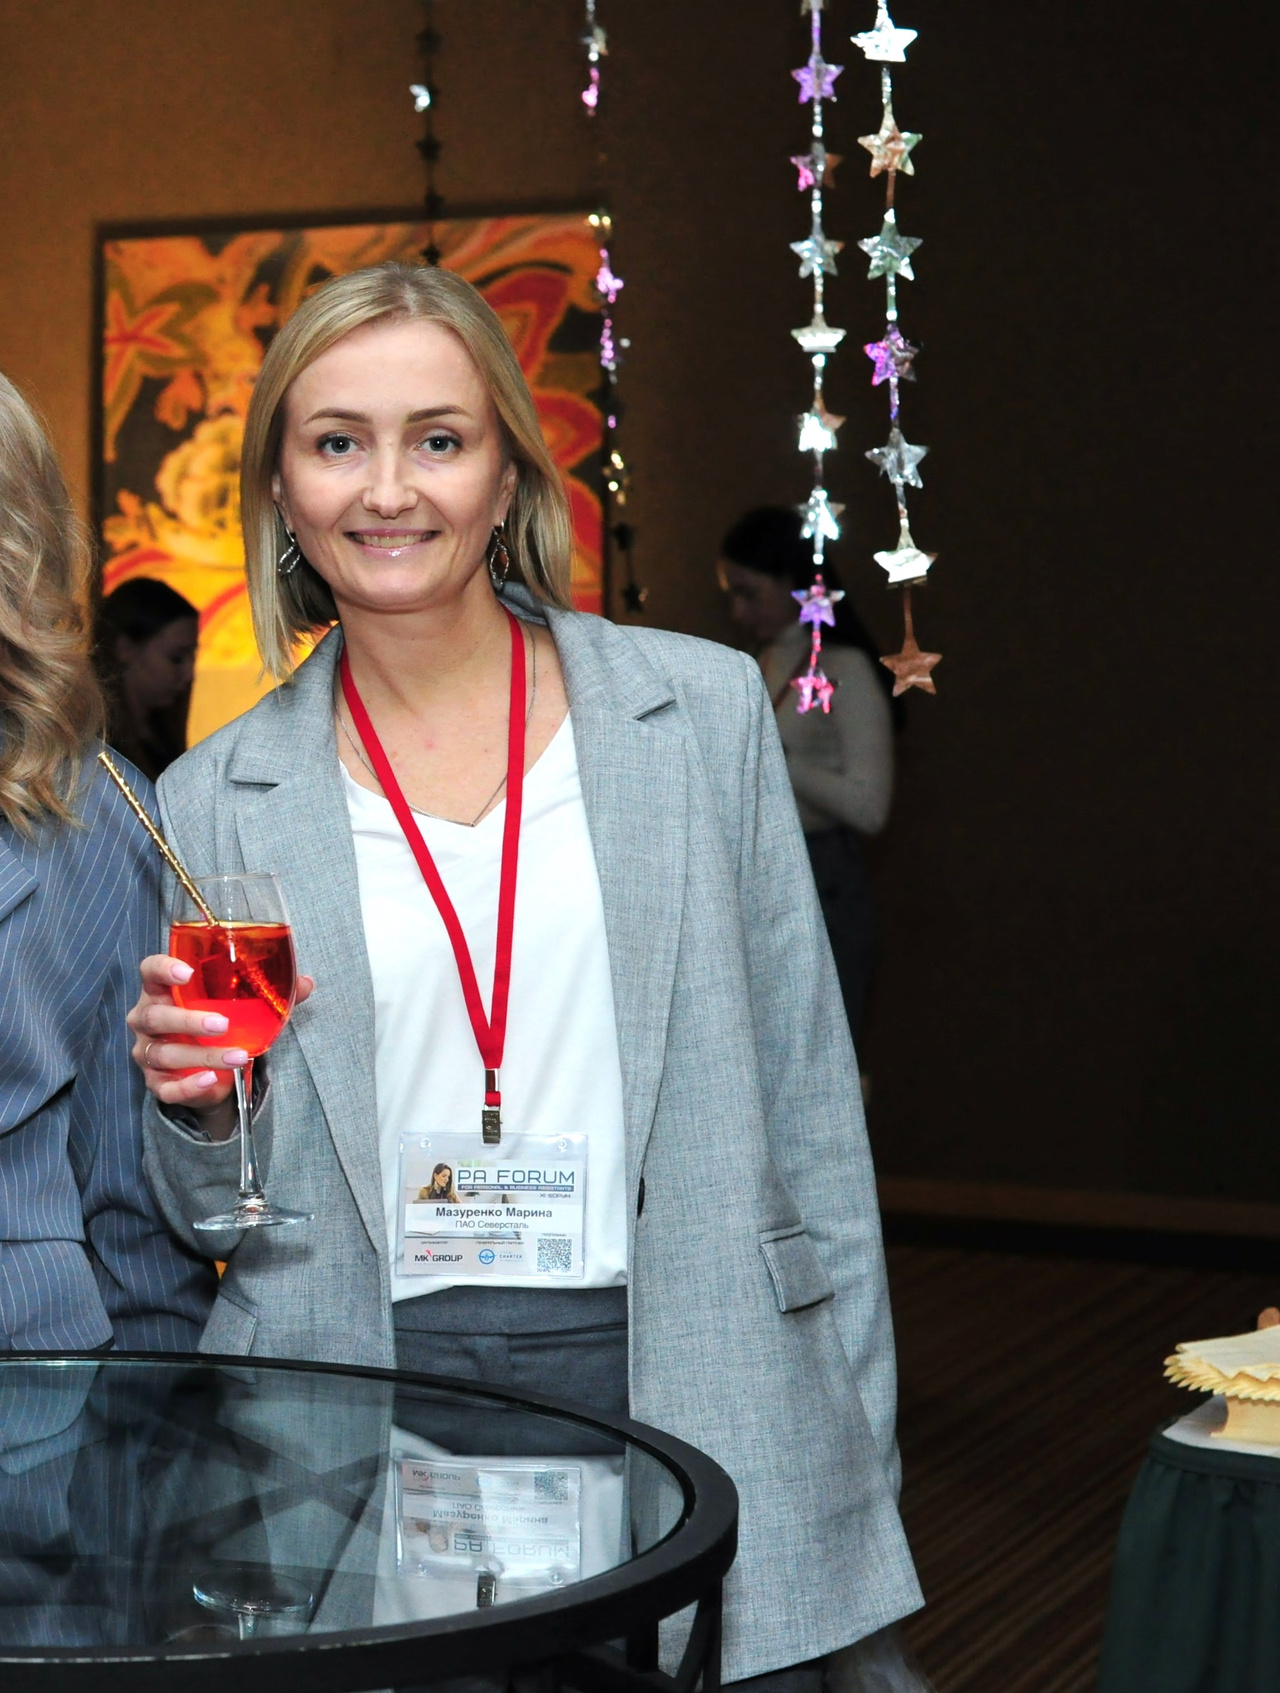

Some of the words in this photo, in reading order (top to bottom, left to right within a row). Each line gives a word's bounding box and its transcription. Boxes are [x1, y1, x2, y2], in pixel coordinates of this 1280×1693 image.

[458, 1169, 487, 1183] PA
[497, 1169, 575, 1184] FORUM
[435, 1207, 503, 1220] Мазуренко
[506, 1207, 553, 1220] Марина
[455, 1220, 476, 1229] ПАО
[477, 1220, 529, 1231] Северсталь
[414, 1254, 429, 1262] MK
[432, 1254, 463, 1262] GROUP
